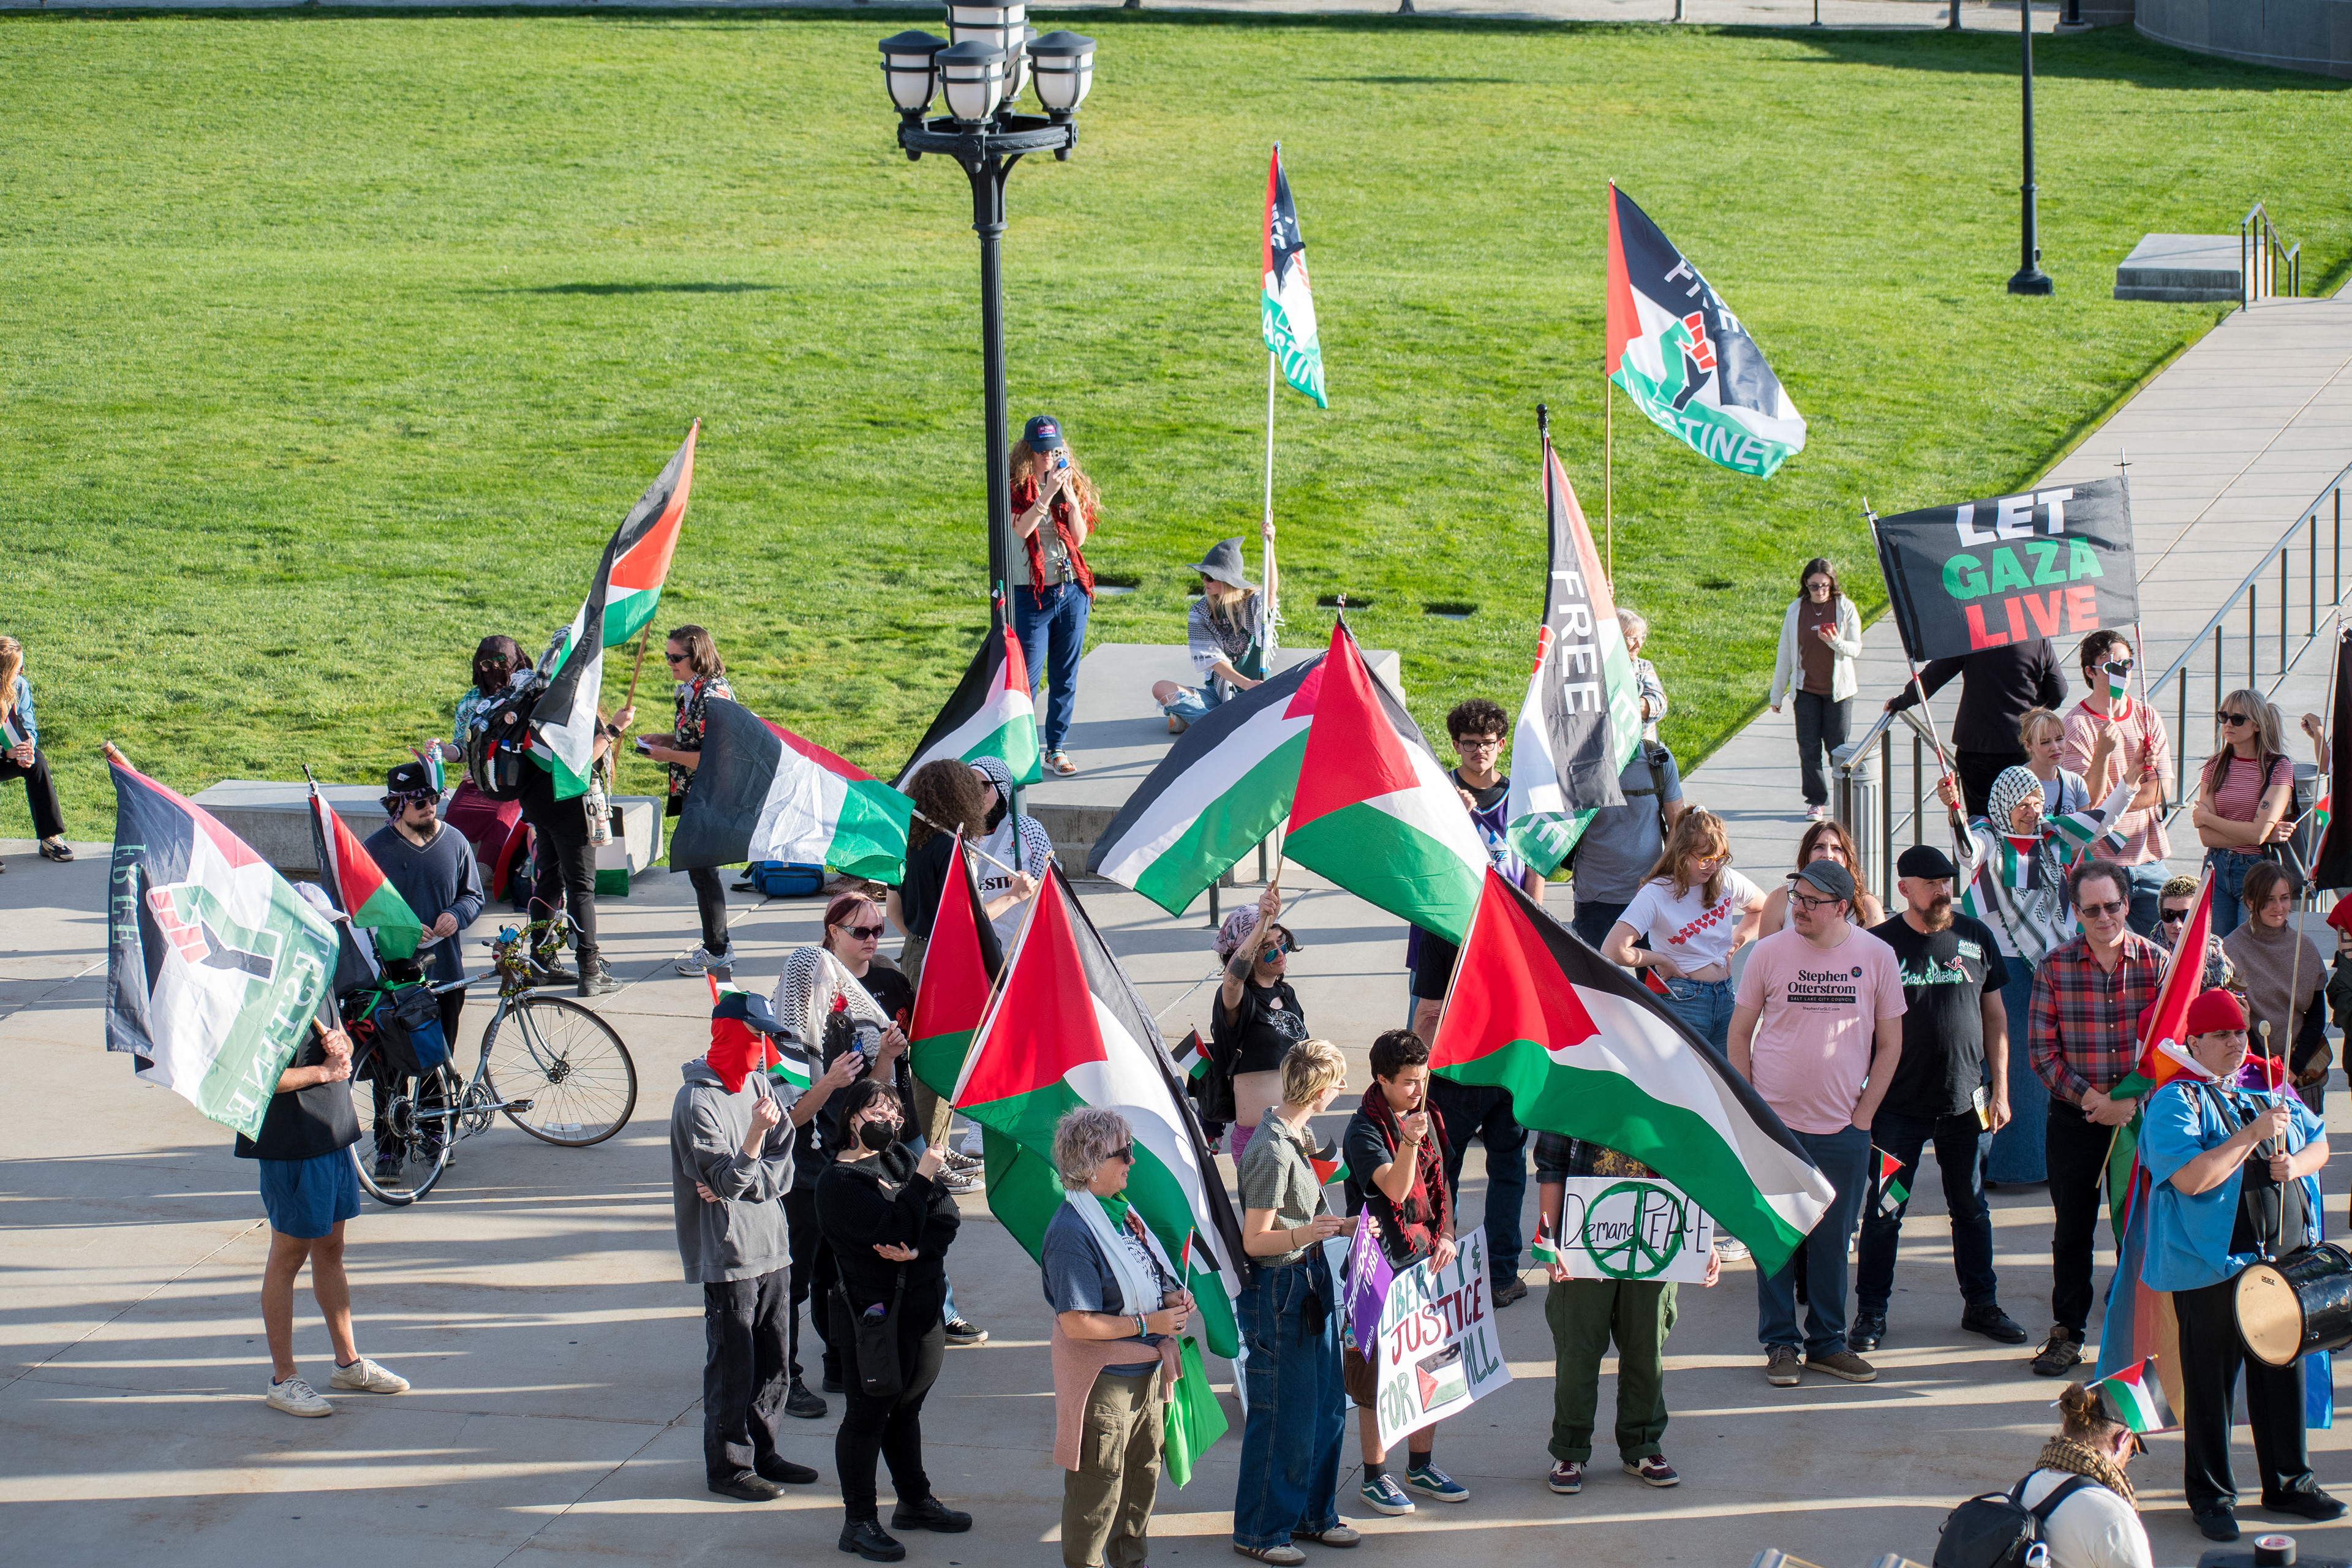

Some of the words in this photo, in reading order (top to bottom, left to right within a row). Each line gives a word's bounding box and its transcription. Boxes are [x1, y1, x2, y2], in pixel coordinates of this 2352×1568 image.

[1956, 488, 2074, 548] LET
[1942, 537, 2104, 600] GAZA
[1551, 570, 1602, 715] FREE
[1965, 585, 2099, 651] LIVE
[1787, 981, 1856, 994] Otterstrom
[1798, 970, 1848, 984] Stephen
[1564, 1193, 1637, 1247] Demand
[1362, 1270, 1373, 1297] TO
[1368, 1243, 1379, 1275] BE
[2261, 1275, 2275, 1285] peace
[1390, 1276, 1485, 1366] JUSTICE
[1379, 1372, 1416, 1440] FOR
[1463, 1325, 1500, 1392] ALL
